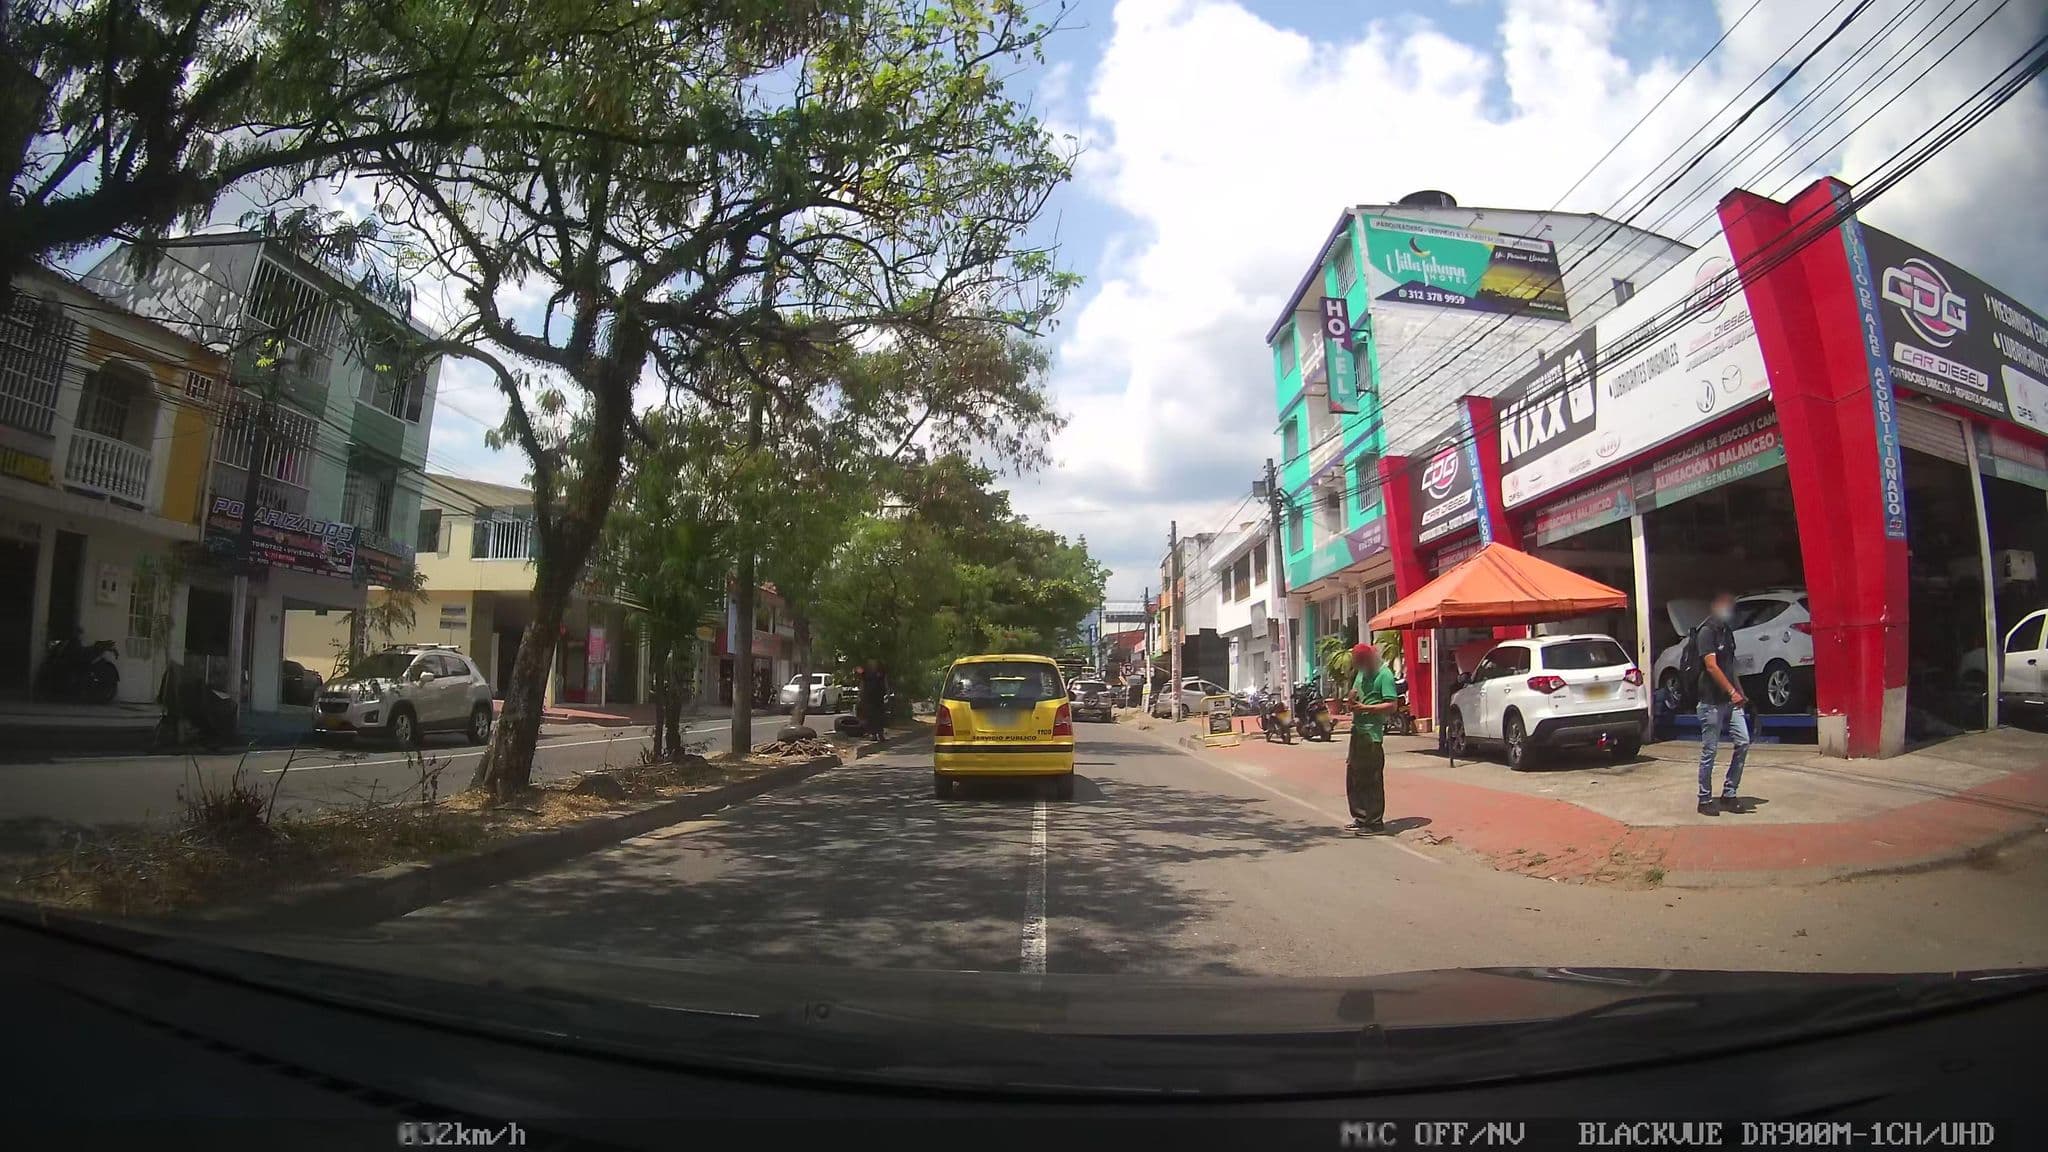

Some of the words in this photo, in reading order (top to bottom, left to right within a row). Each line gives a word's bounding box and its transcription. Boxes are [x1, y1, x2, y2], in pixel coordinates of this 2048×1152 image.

[1408, 289, 1424, 299] 312
[1427, 292, 1443, 301] 378
[1430, 274, 1468, 284] HOTEL
[1882, 267, 1967, 331] CDG
[1714, 310, 1751, 338] DIESEL
[1326, 300, 1349, 395] HOTEL
[1901, 349, 1934, 369] CAR
[1938, 360, 1984, 387] DIESEL
[1499, 391, 1567, 465] KIXX
[1756, 411, 1777, 429] CAM
[1865, 314, 1881, 357] AIRE
[1874, 367, 1901, 515] ACONDICIONADO
[1710, 455, 1719, 471] Y
[1718, 431, 1776, 466] BALANCEO
[1421, 453, 1457, 491] CDG
[213, 497, 354, 541] POARIZADOS
[252, 541, 283, 552] TOMOTRIZ
